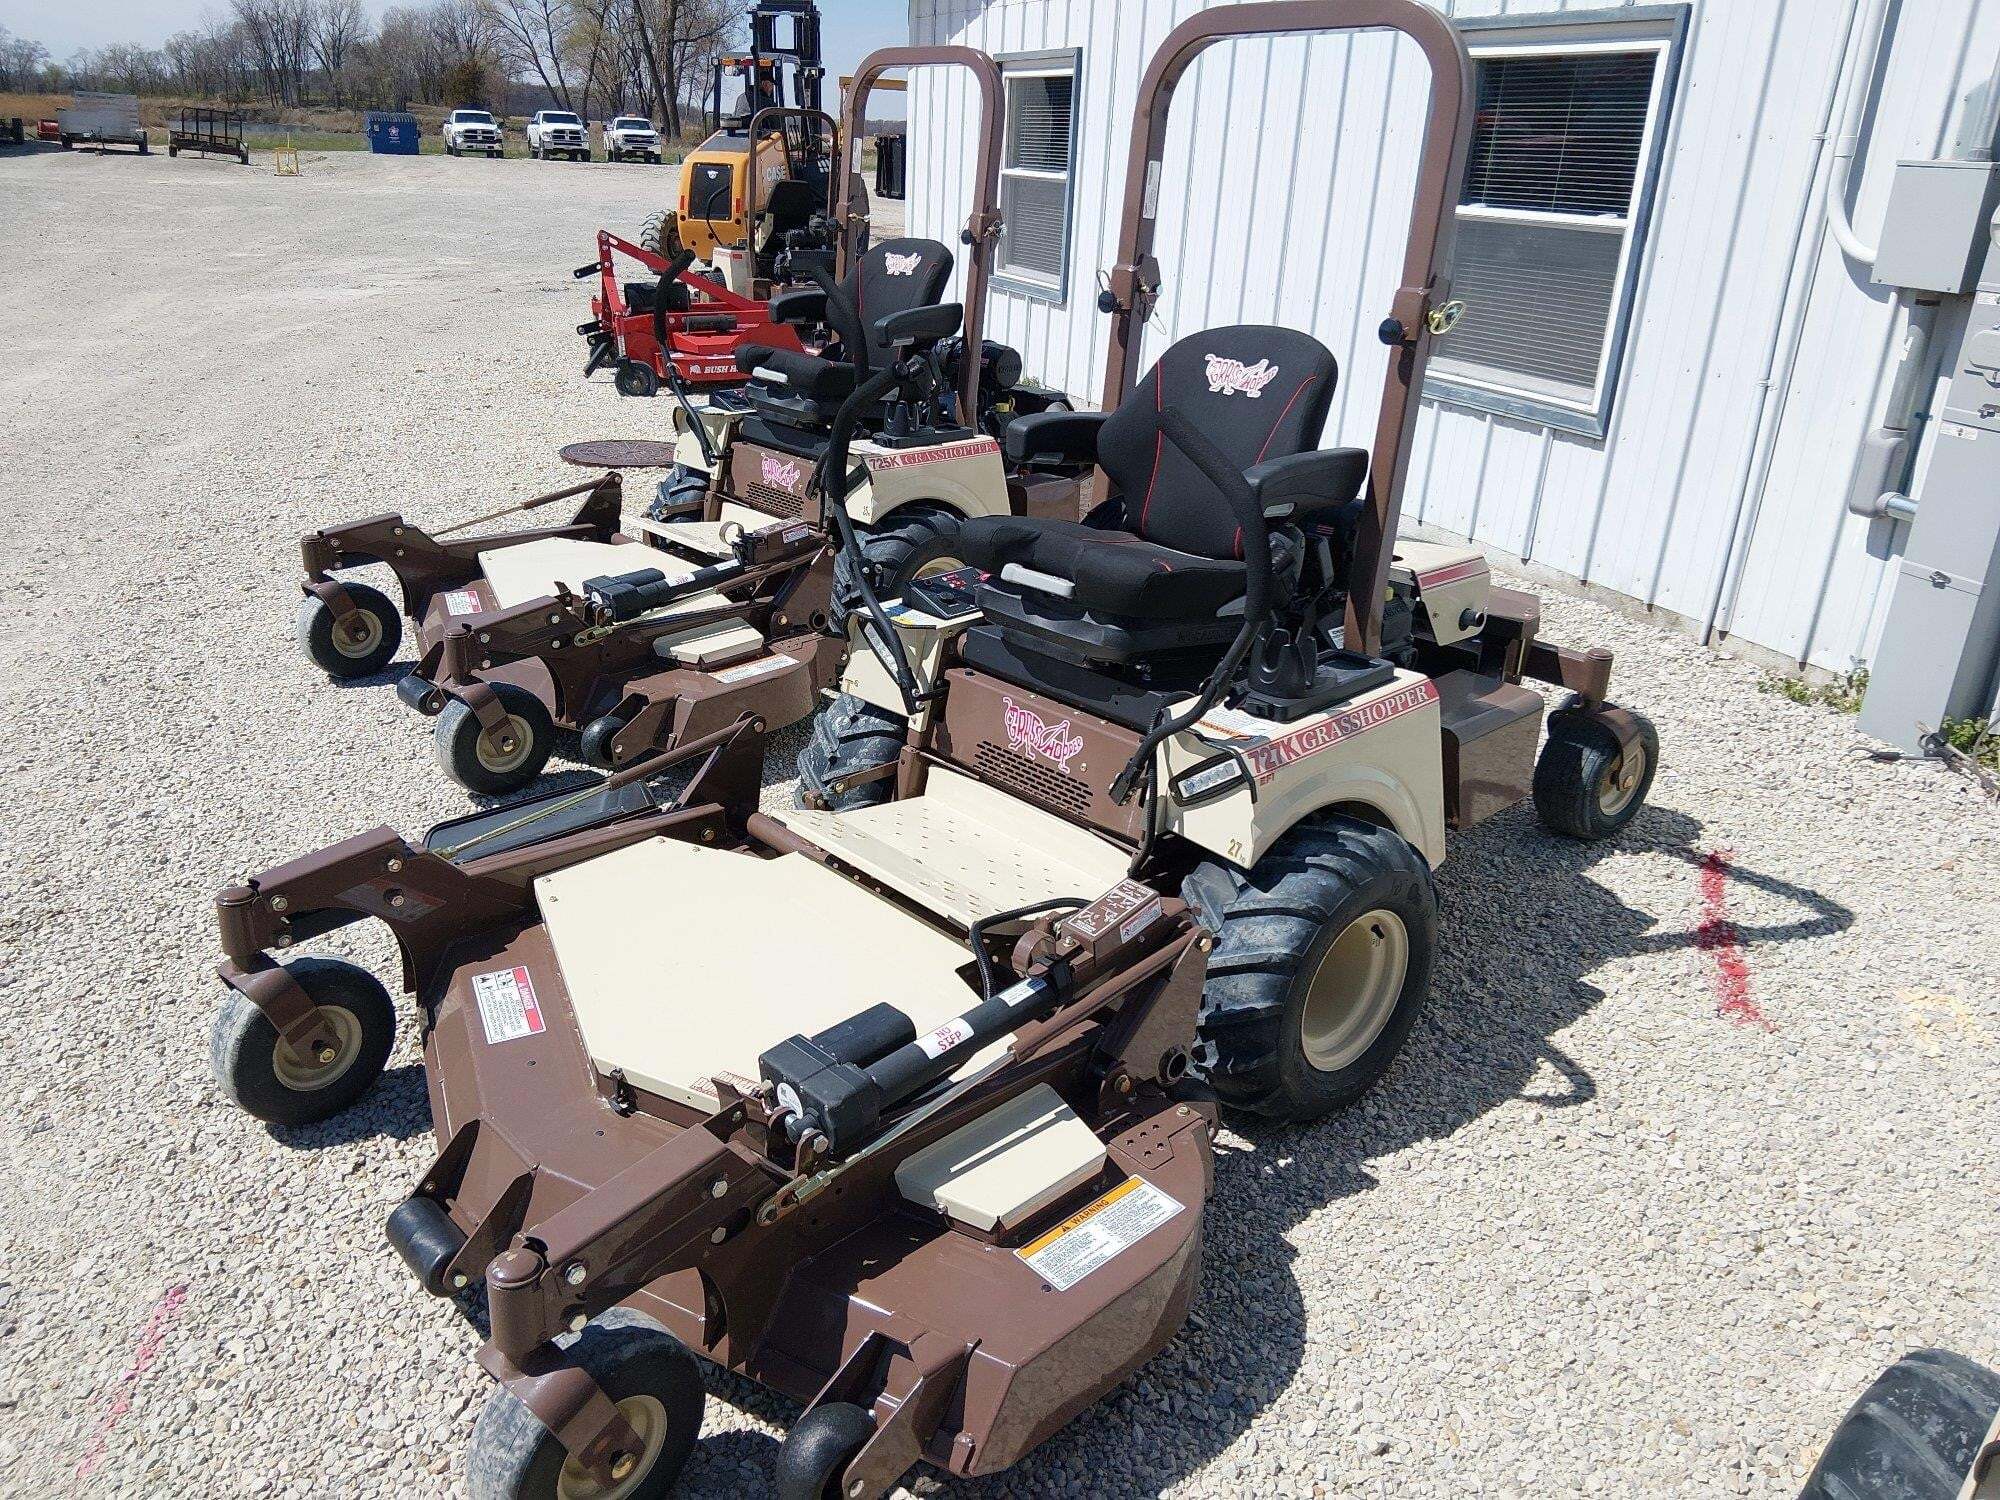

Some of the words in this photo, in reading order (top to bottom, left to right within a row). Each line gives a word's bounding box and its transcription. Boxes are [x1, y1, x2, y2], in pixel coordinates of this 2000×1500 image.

[704, 365, 729, 374] BUSH
[869, 455, 900, 470] 725K
[904, 442, 993, 465] GRASSHOPPER
[1247, 738, 1300, 774] 727K
[1302, 685, 1430, 751] GRASSHOPPER
[1227, 838, 1242, 858] 27
[935, 1026, 951, 1039] NO
[937, 1031, 962, 1051] STEP
[1071, 1199, 1110, 1226] WARNING
